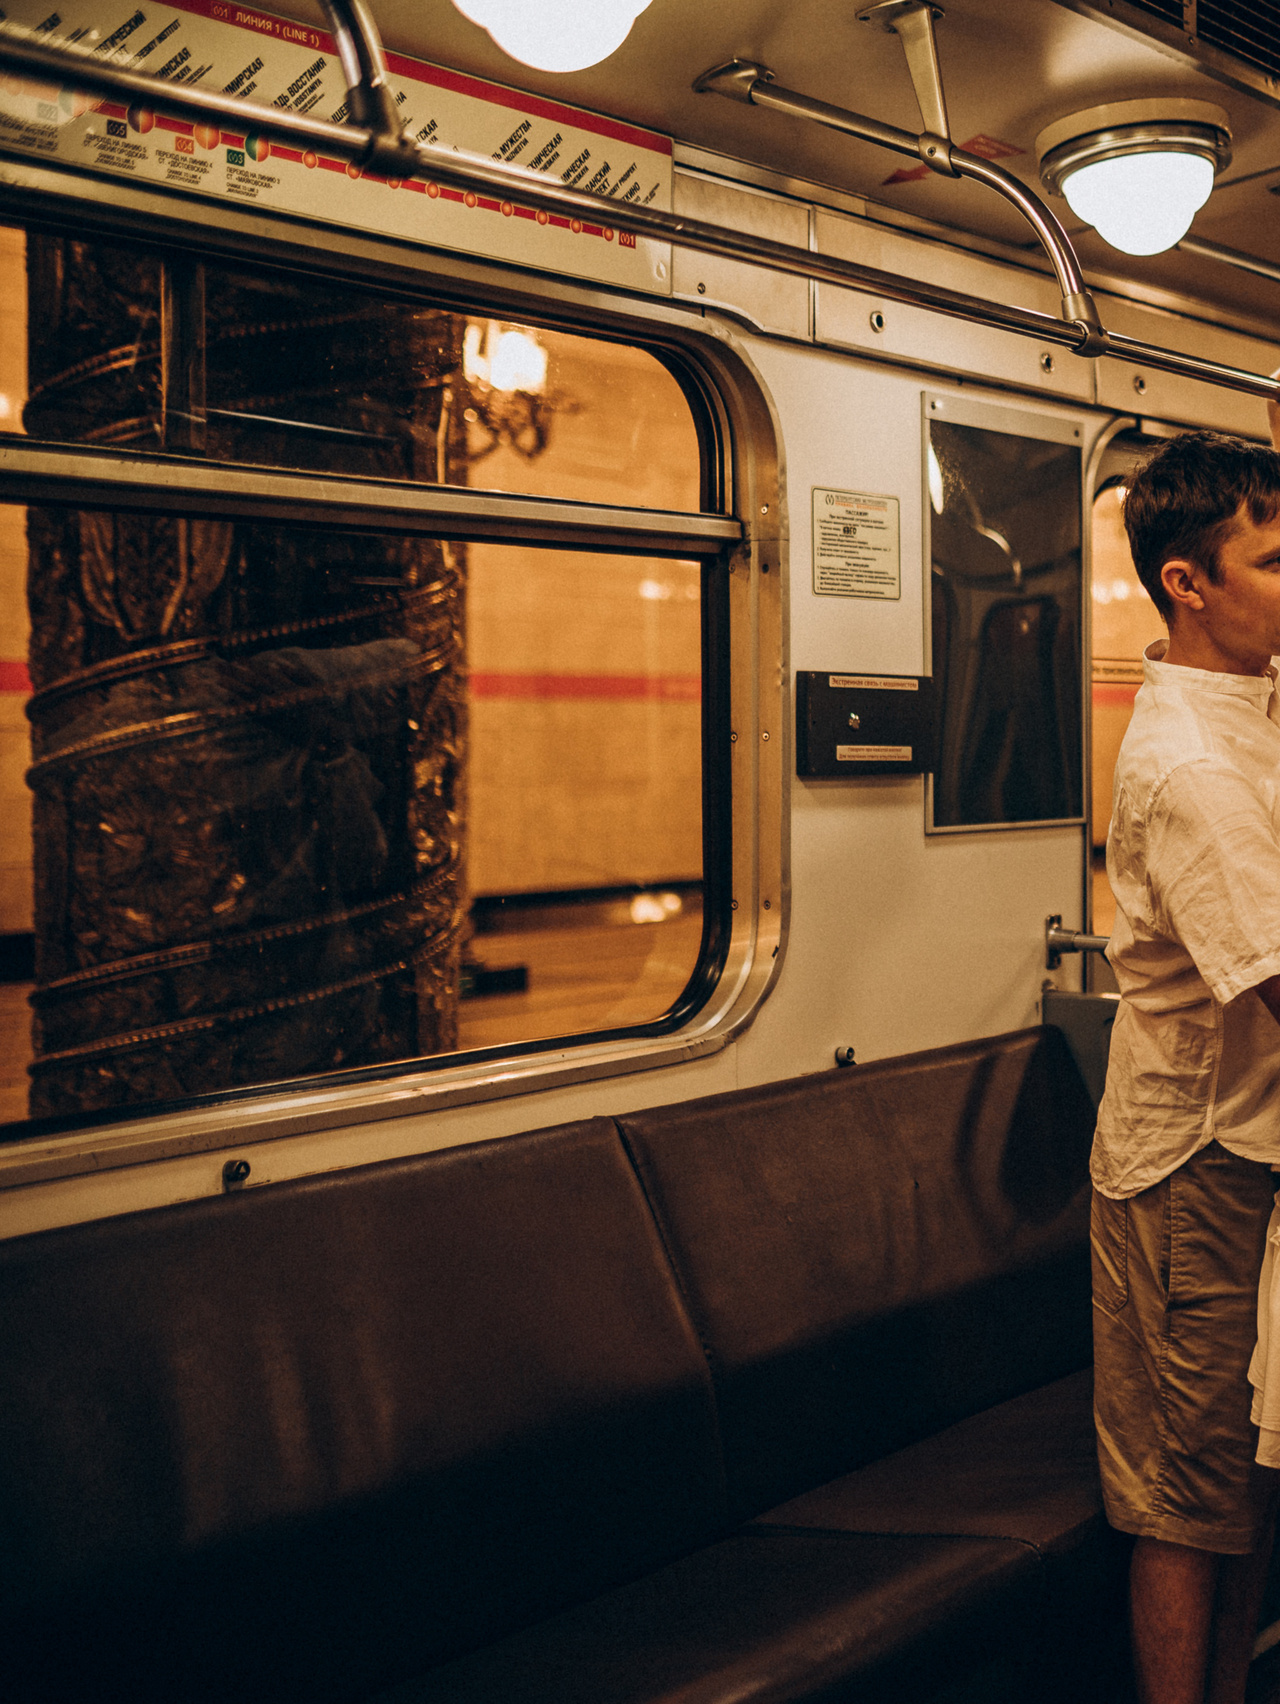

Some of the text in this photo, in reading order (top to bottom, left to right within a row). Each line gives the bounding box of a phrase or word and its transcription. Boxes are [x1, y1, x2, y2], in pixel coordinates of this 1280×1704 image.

[93, 9, 147, 54] ОГИЧЕСКИЙ
[236, 12, 273, 32] ЛИНИЯ
[275, 23, 281, 34] 1
[283, 26, 308, 42] (LINE
[310, 34, 320, 48] 1)
[154, 47, 192, 78] ИНСКАЯ
[222, 57, 264, 95] ИМИРСКАЯ
[286, 57, 327, 97] ВОССТАНИЯ
[293, 78, 323, 108] VOSSTANIYA
[415, 119, 438, 143] ГСКАЯ
[499, 119, 532, 155] МУЖЕСТВА
[527, 132, 563, 170] ХНИЧЕСКАЯ
[583, 161, 611, 192] ДАНСКИЙ
[621, 181, 641, 202] ТКИНО
